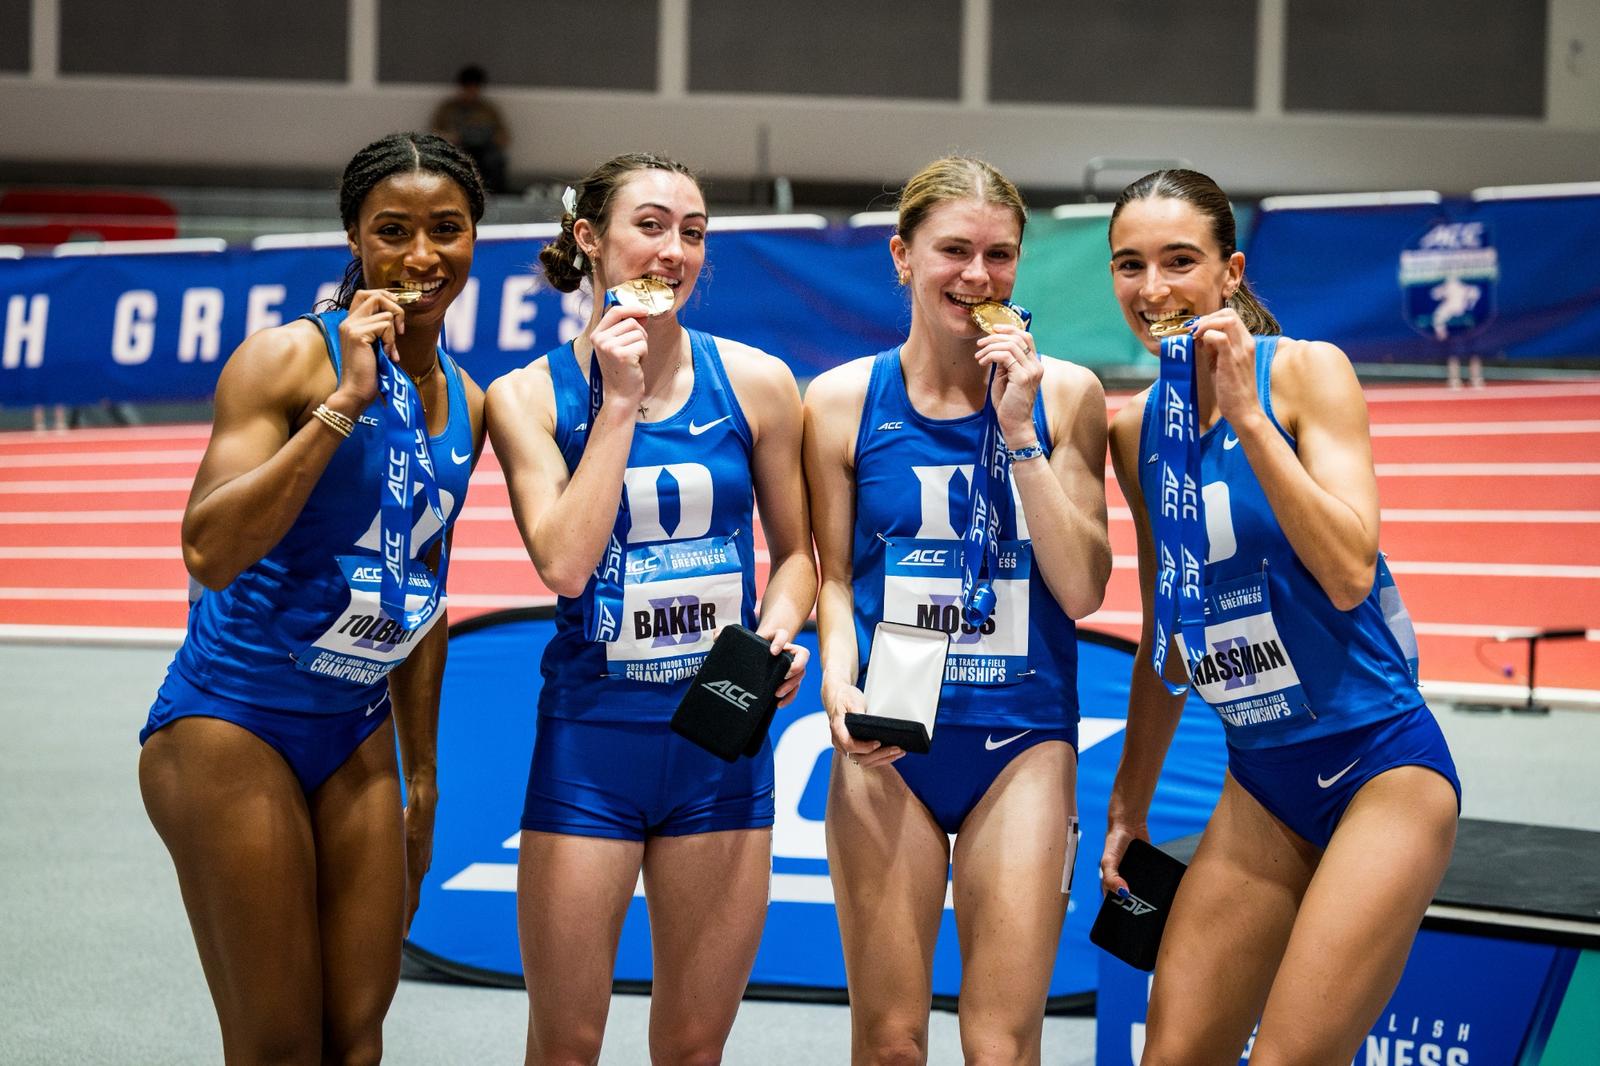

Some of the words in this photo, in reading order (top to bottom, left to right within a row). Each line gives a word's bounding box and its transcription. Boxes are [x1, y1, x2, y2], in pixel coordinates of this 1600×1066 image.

[878, 422, 904, 430] ACC
[1169, 386, 1184, 442] ACC
[388, 447, 406, 505] ACC
[1165, 467, 1179, 522] ACC
[1183, 473, 1198, 522] ACC
[972, 493, 987, 546] ACC
[385, 529, 400, 584] ACC
[671, 553, 727, 570] GREATNESS
[901, 550, 949, 563] ACC
[1184, 547, 1200, 600] ACC
[1220, 592, 1263, 611] GREATNESS
[633, 602, 717, 640] BAKER
[626, 664, 703, 683] CHAMPIONS
[645, 662, 659, 670] ACC
[684, 656, 702, 666] TRACK
[945, 666, 1007, 682] IONSHIPS
[958, 658, 980, 667] TRACK
[987, 659, 1006, 668] FIELD
[708, 679, 759, 708] ACC
